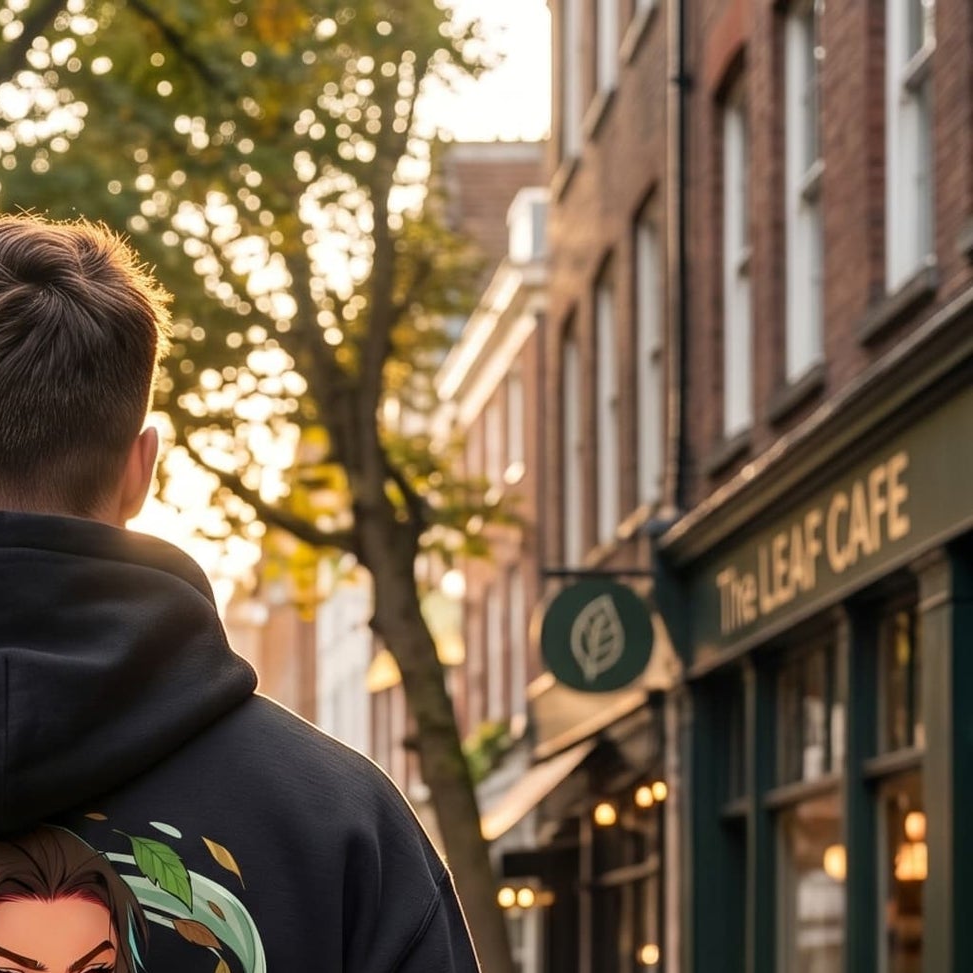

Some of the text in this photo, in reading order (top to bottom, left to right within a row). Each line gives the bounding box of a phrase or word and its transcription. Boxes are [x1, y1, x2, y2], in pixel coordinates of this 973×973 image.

[716, 451, 911, 635] The LEAF CAFE
